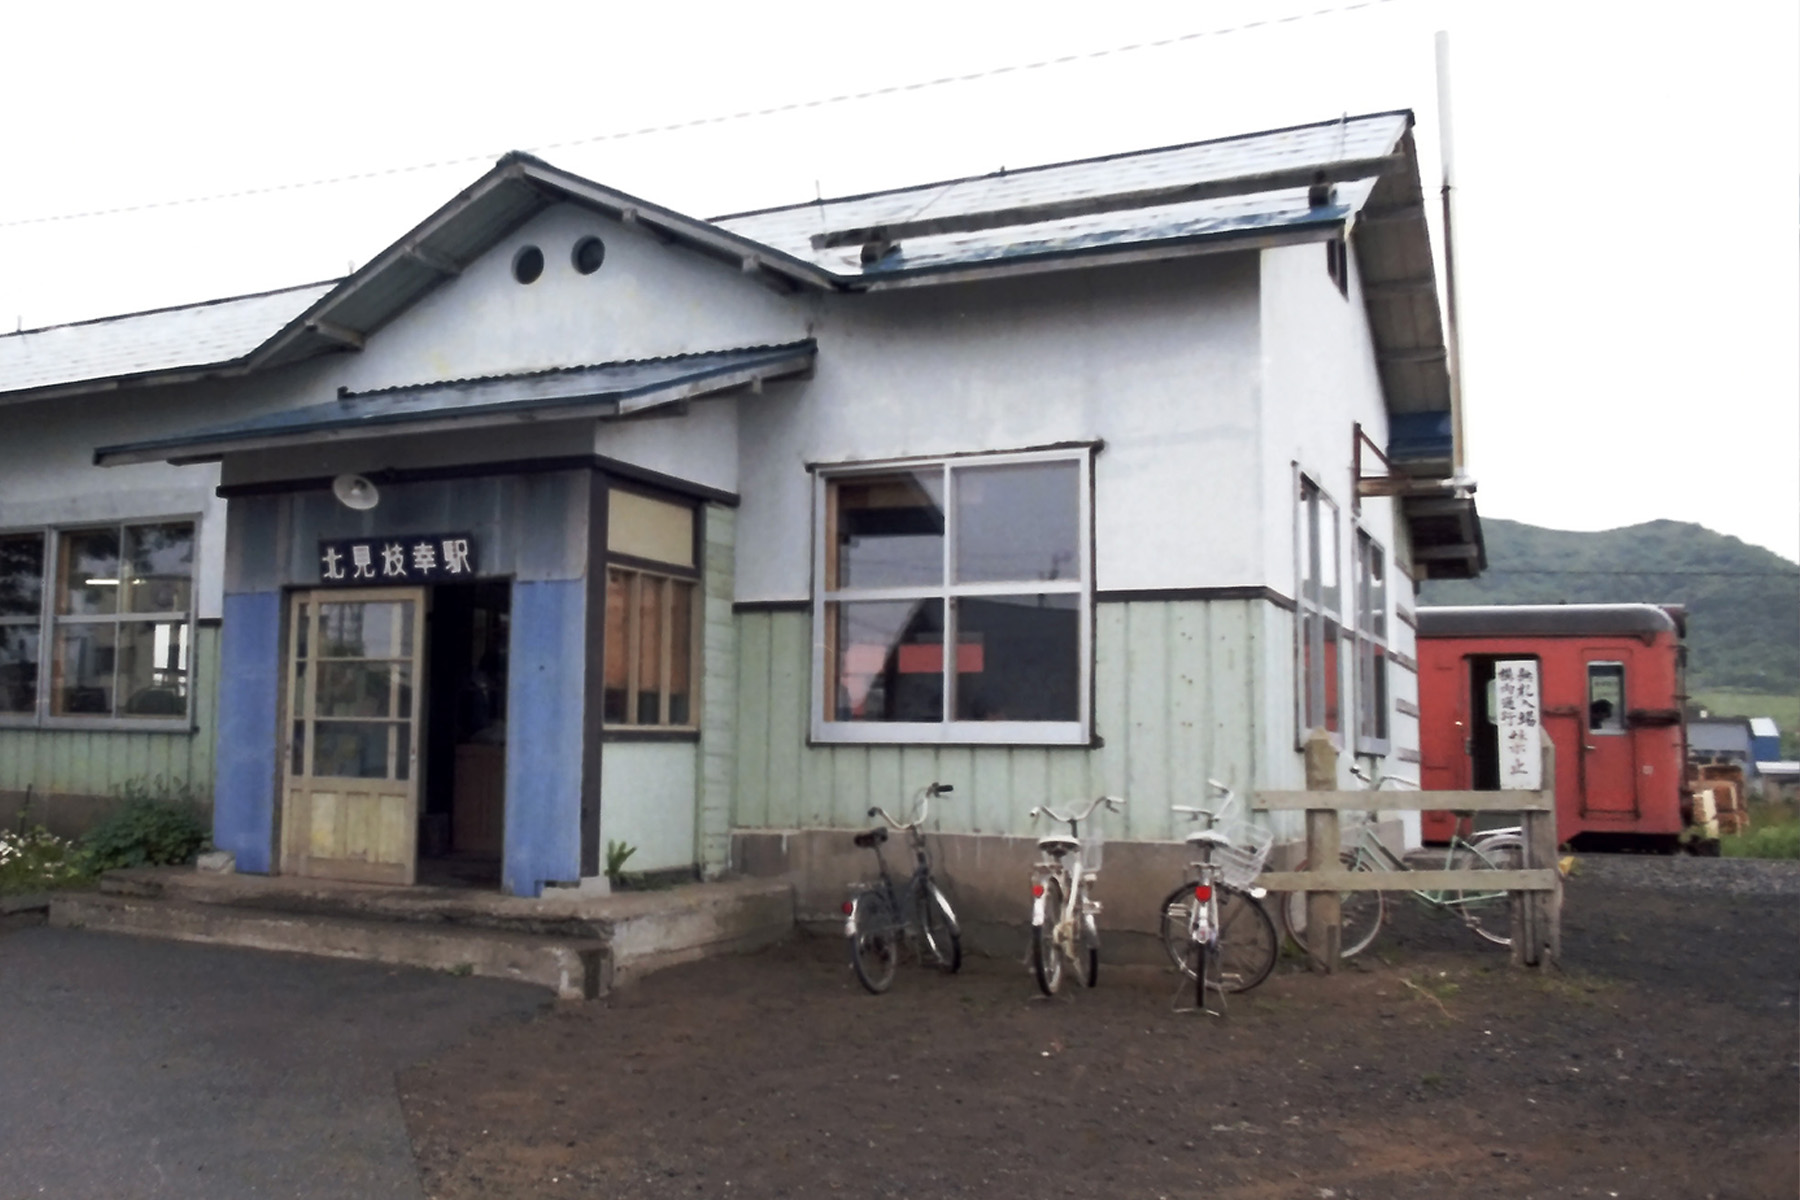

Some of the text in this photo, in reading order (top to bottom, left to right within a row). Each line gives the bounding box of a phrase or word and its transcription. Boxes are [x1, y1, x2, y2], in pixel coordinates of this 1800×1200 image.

[321, 539, 472, 579] 北見枝幸駅
